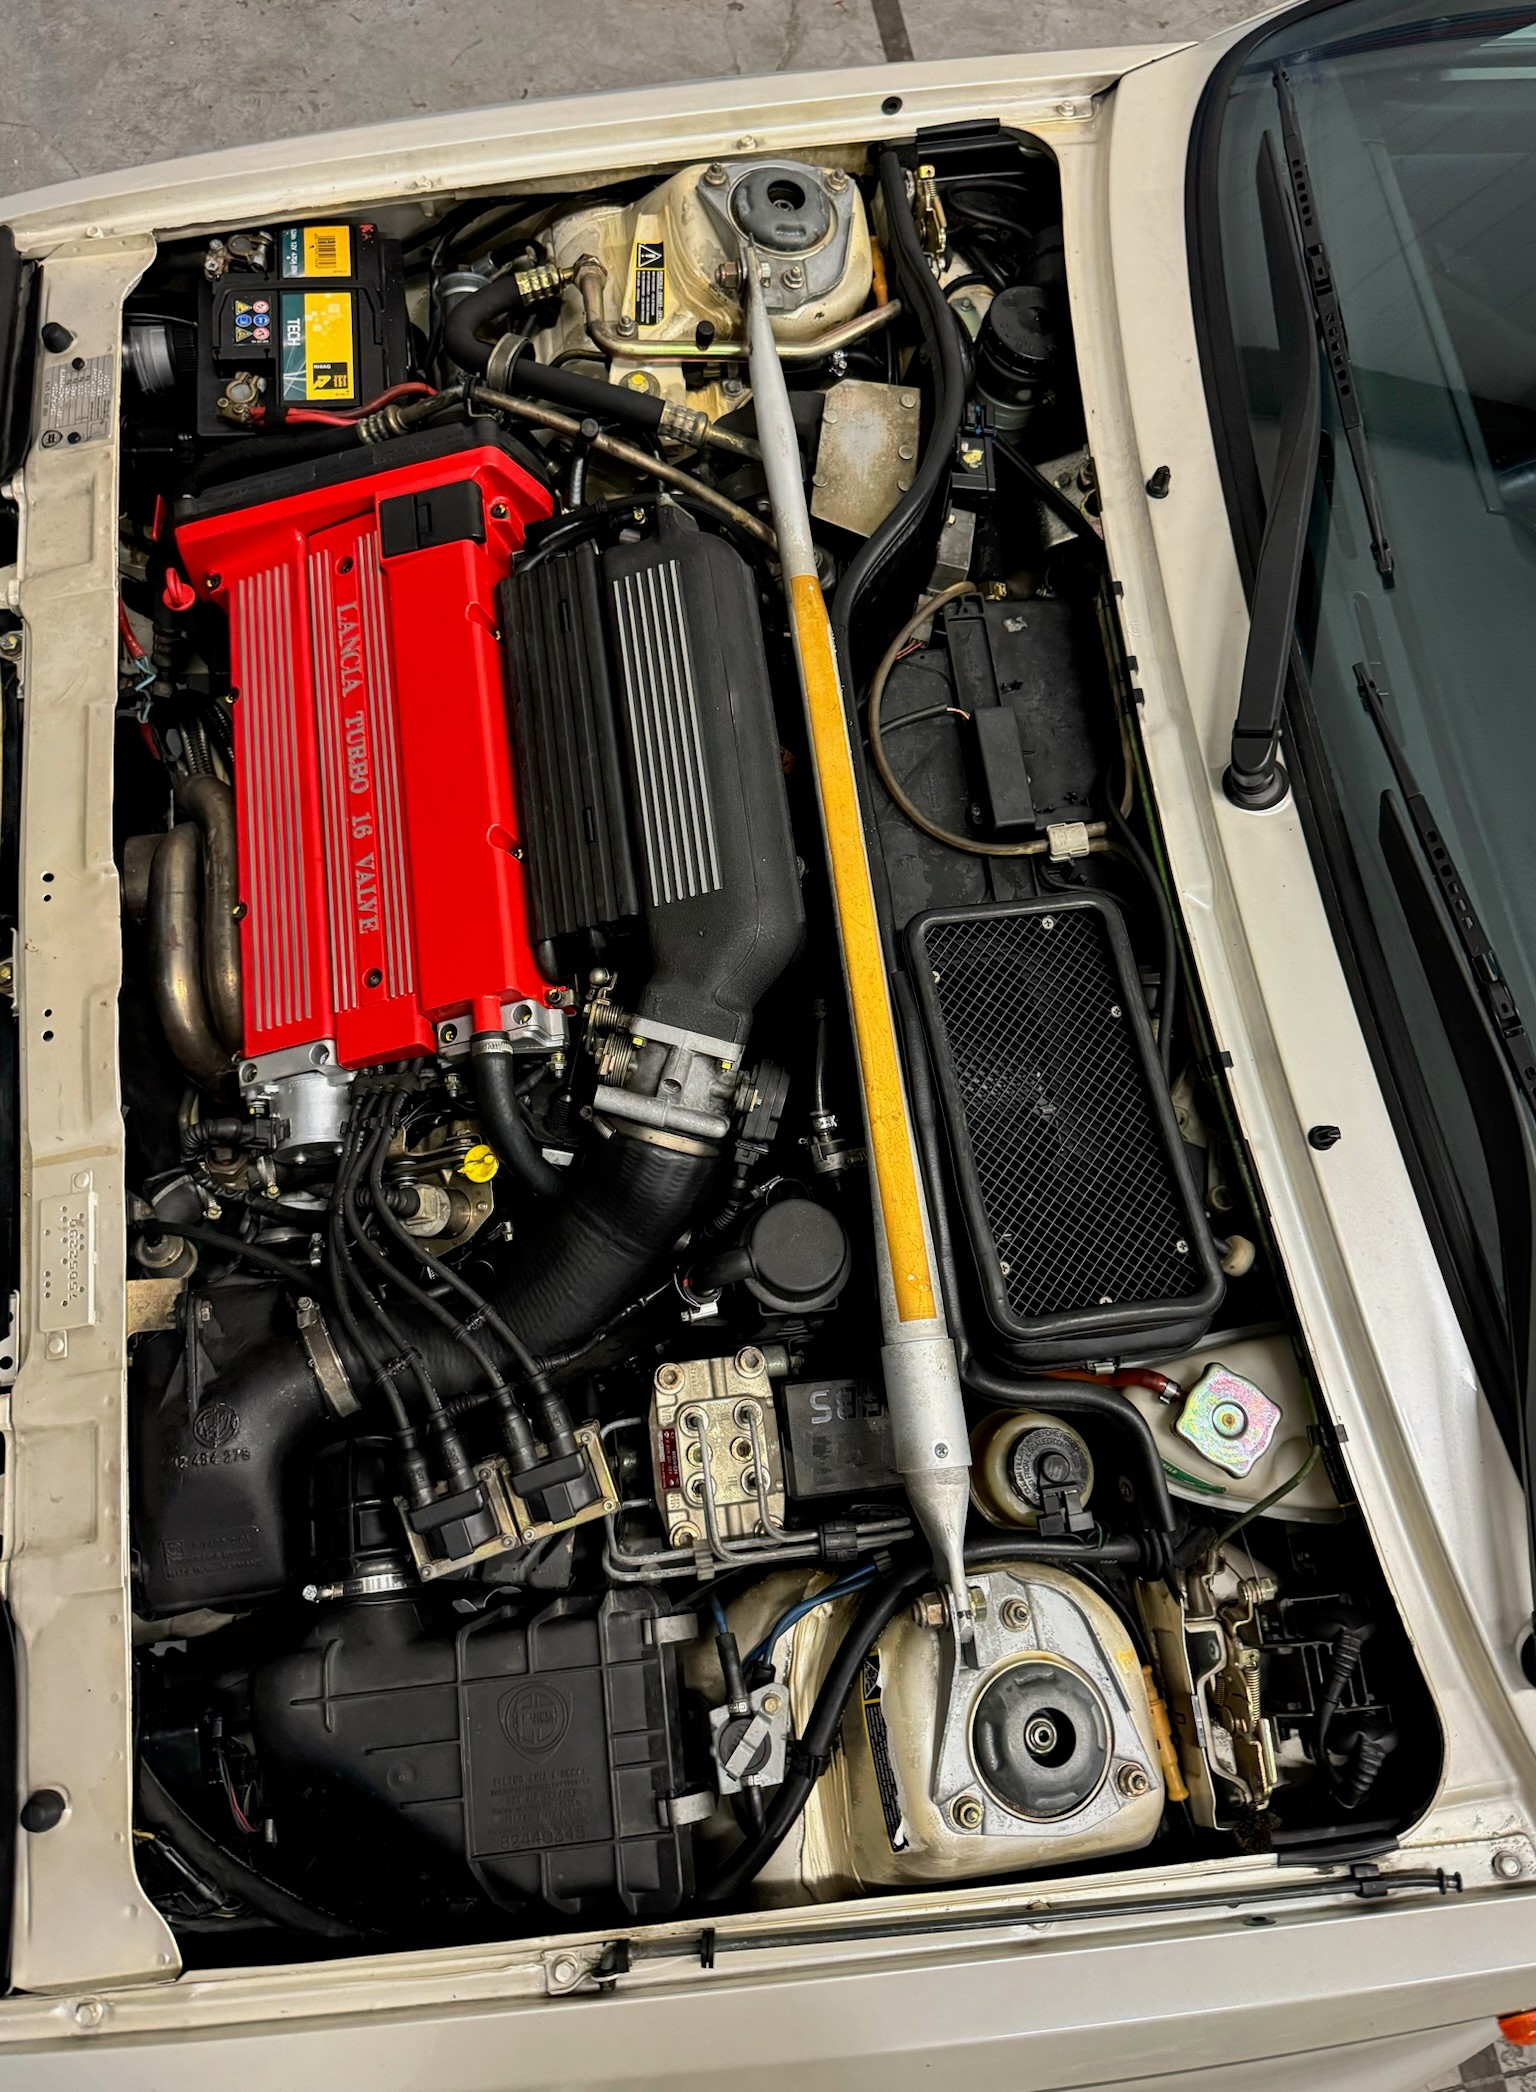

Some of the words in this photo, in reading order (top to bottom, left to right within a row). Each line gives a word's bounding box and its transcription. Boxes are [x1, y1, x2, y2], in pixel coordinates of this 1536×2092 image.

[287, 318, 301, 347] TECH
[336, 600, 364, 699] LANCIA
[344, 710, 370, 795] TURBO
[351, 811, 373, 840] 16
[355, 851, 380, 935] VALVE
[671, 1450, 679, 1475] BOSCH
